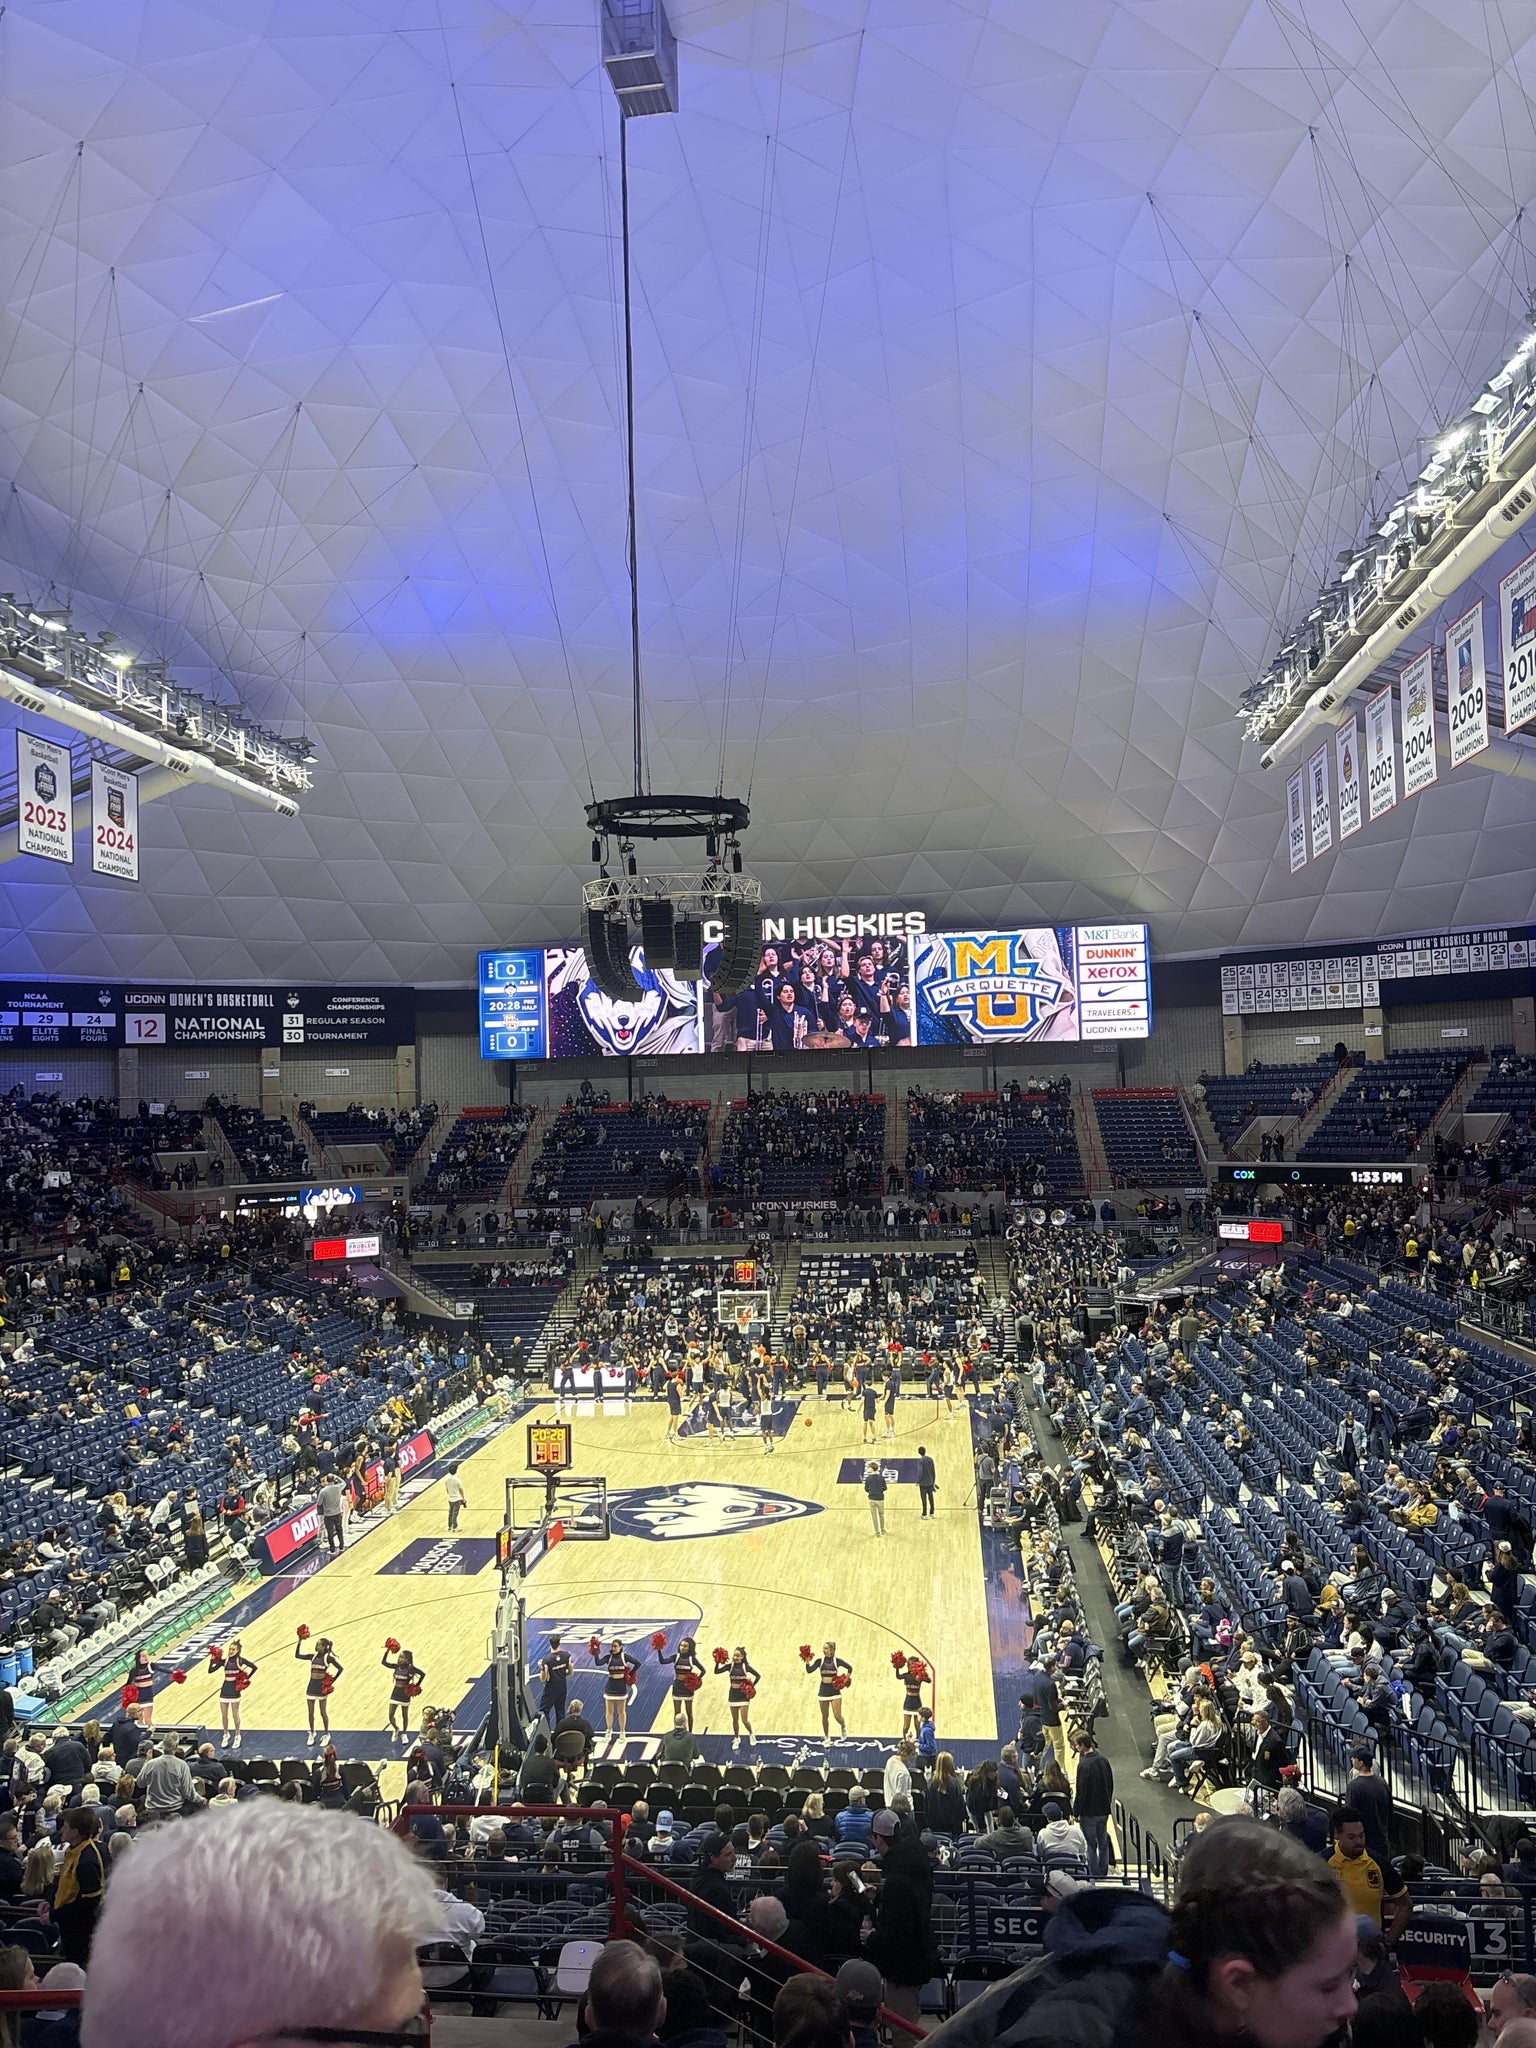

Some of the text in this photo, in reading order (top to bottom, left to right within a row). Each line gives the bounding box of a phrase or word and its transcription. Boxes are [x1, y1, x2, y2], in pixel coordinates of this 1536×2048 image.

[1510, 575, 1534, 598] Basketball
[1451, 687, 1484, 731] 2009
[1455, 721, 1481, 744] NATIONAL
[27, 737, 46, 750] UConn
[1405, 725, 1433, 763] 2004
[1454, 735, 1484, 761] CHAMPIONS
[100, 766, 116, 778] UConn
[1370, 755, 1392, 790] 2003
[1409, 756, 1431, 777] NATIONAL
[1407, 769, 1433, 791] CHAMPIONS
[1340, 781, 1358, 811] 2002
[1372, 796, 1393, 816] CHAMPIONS
[24, 801, 67, 832] 2023
[1312, 803, 1329, 832] 2000
[28, 828, 65, 845] NATIONAL
[97, 825, 134, 853] 2024
[1291, 824, 1303, 847] 1995
[25, 841, 68, 859] CHAMPIONS
[100, 849, 131, 864] NATIONAL
[98, 861, 134, 877] CHAMPIONS
[793, 911, 926, 939] HUSKIES
[1084, 928, 1139, 940] M&T Bank
[1377, 930, 1508, 951] UCONN WOMEN'S HUSKIES OF HONOR
[1434, 950, 1448, 959] 20
[1473, 946, 1484, 956] 31
[1491, 945, 1506, 955] 23
[1309, 961, 1322, 970] 33
[1328, 960, 1338, 969] 21
[1344, 958, 1358, 967] 42
[1367, 957, 1373, 966] 3
[1380, 955, 1393, 964] 52
[506, 964, 516, 975] 0
[1087, 966, 1138, 979] xerox
[1223, 968, 1235, 976] 25
[1240, 966, 1252, 975] 24
[1258, 965, 1268, 974] 10
[1274, 964, 1287, 973] 32
[1291, 962, 1304, 972] 50
[938, 979, 1051, 999] MARQUETTE
[1275, 989, 1288, 998] 33
[1367, 983, 1374, 992] 5
[125, 993, 274, 1007] UCONN WOMEN'S BASKETBALL
[1242, 991, 1252, 999] 15
[1257, 990, 1270, 998] 24
[7, 1001, 64, 1009] TOURNAMENT
[489, 1001, 520, 1011] 20:28
[1087, 1008, 1132, 1017] TRAVELERS
[38, 1015, 54, 1024] 29
[86, 1015, 102, 1025] 24
[174, 1017, 265, 1030] NATIONAL
[288, 1017, 385, 1025] 31 REGULAR SEASON
[134, 1019, 158, 1038] 12
[1086, 1026, 1117, 1034] UCONN
[174, 1031, 266, 1040] CHAMPIONSHIPS
[286, 1032, 301, 1040] 30
[507, 1036, 518, 1047] 0
[1234, 1170, 1255, 1179] COX
[1351, 1171, 1402, 1183] 1:33 PM
[752, 1201, 837, 1210] UCONN HUSKIES
[738, 1269, 752, 1280] 30
[532, 1428, 565, 1441] 20:28
[405, 1538, 460, 1575] MADISON
[428, 1552, 463, 1575] REED
[156, 1622, 233, 1664] UCONN
[994, 1918, 1038, 1936] SEC
